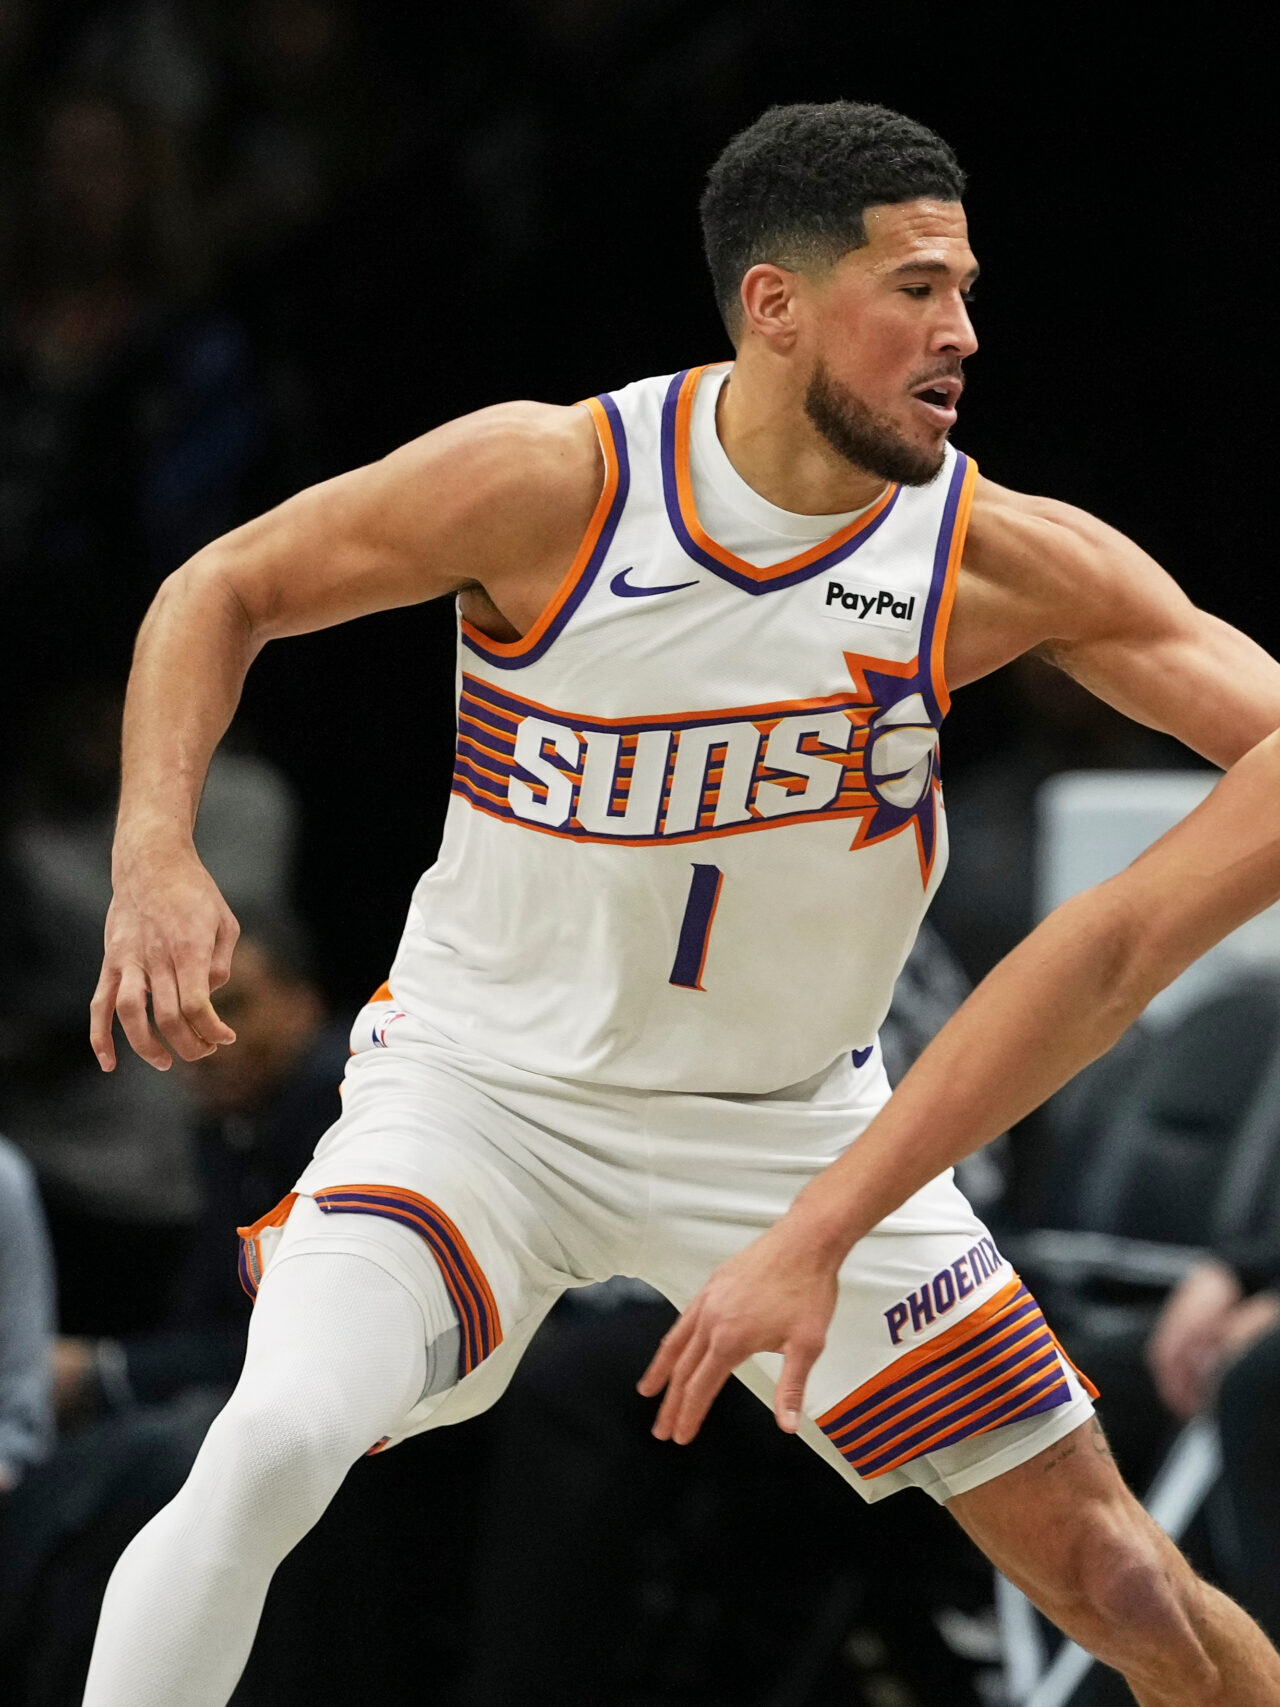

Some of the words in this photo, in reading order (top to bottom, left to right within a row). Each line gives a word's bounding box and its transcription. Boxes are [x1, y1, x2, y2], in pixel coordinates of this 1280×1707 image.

[825, 581, 916, 621] PayPal
[507, 711, 852, 836] SUNS
[668, 862, 724, 993] 1
[883, 1236, 1004, 1346] PHOENIX
